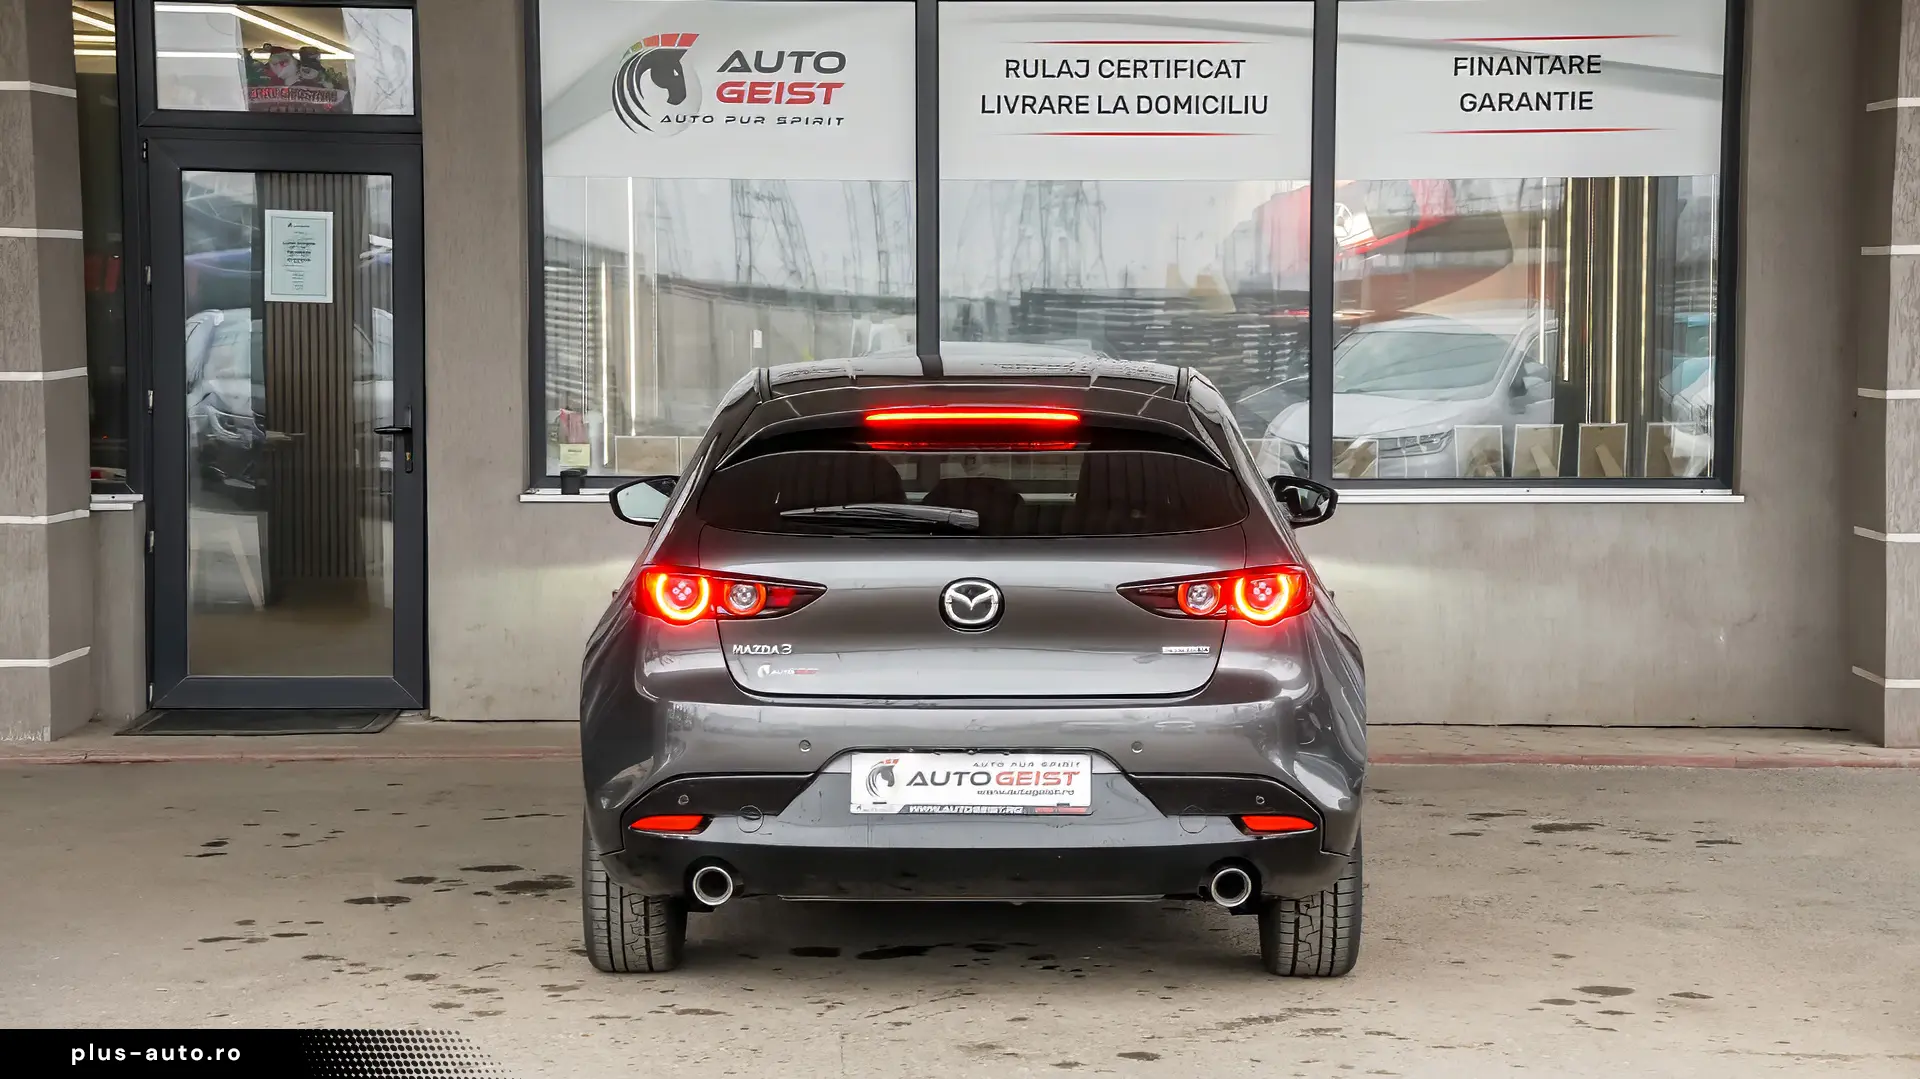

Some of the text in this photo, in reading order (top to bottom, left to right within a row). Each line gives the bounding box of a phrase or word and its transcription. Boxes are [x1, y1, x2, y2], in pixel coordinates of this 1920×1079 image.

[716, 49, 847, 74] AUTO
[1004, 58, 1247, 79] RULAJ CERTIFICAT
[1453, 54, 1603, 77] FINANTARE
[716, 80, 846, 105] GEIST
[1459, 91, 1594, 113] GARANTIE
[980, 94, 1269, 115] LIVRARE LA DOMICILIU
[660, 114, 845, 127] AUTO PUR SPIRIT
